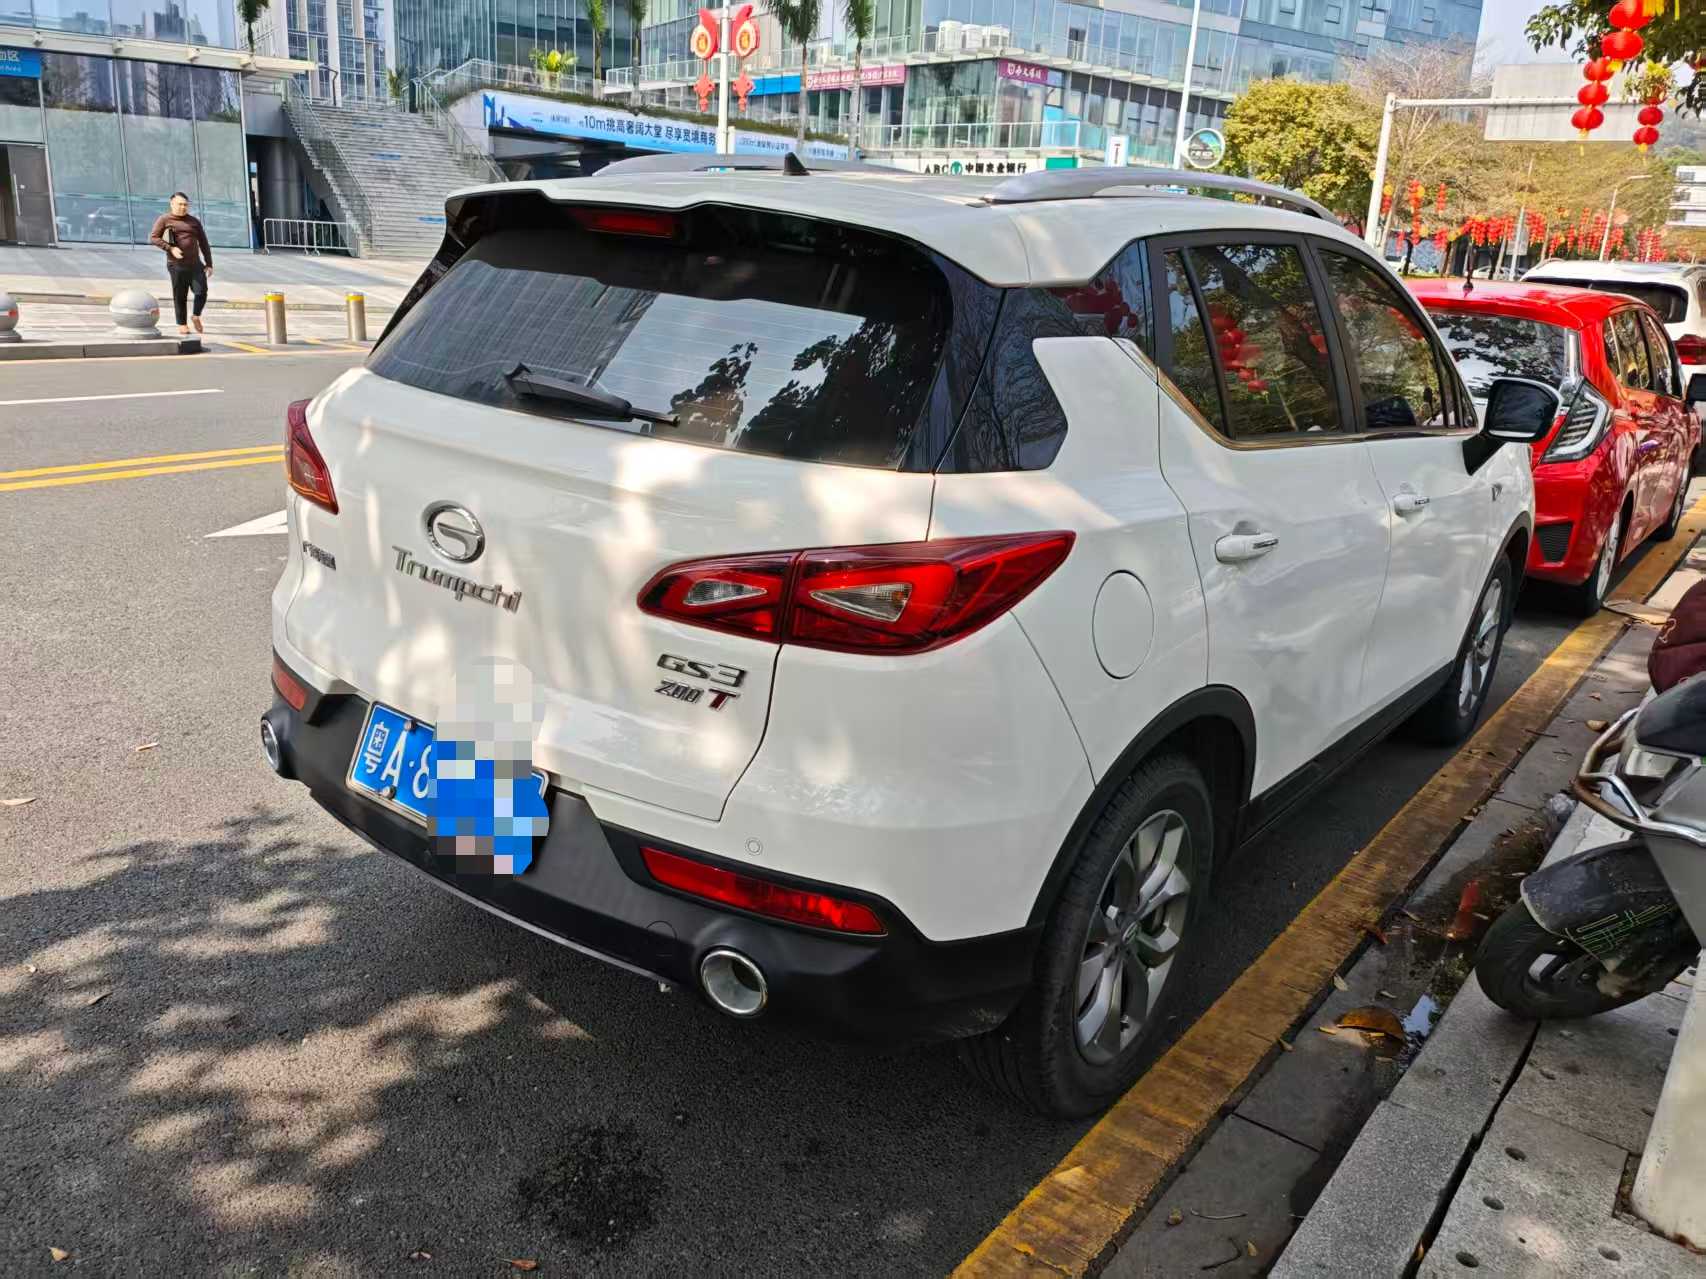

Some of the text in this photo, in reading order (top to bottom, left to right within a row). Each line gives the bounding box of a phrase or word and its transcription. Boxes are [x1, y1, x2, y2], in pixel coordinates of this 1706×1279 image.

[924, 164, 949, 175] ABC
[965, 162, 1027, 173] 中国农业银行
[391, 545, 522, 613] Trumpchi
[657, 653, 747, 687] GS3
